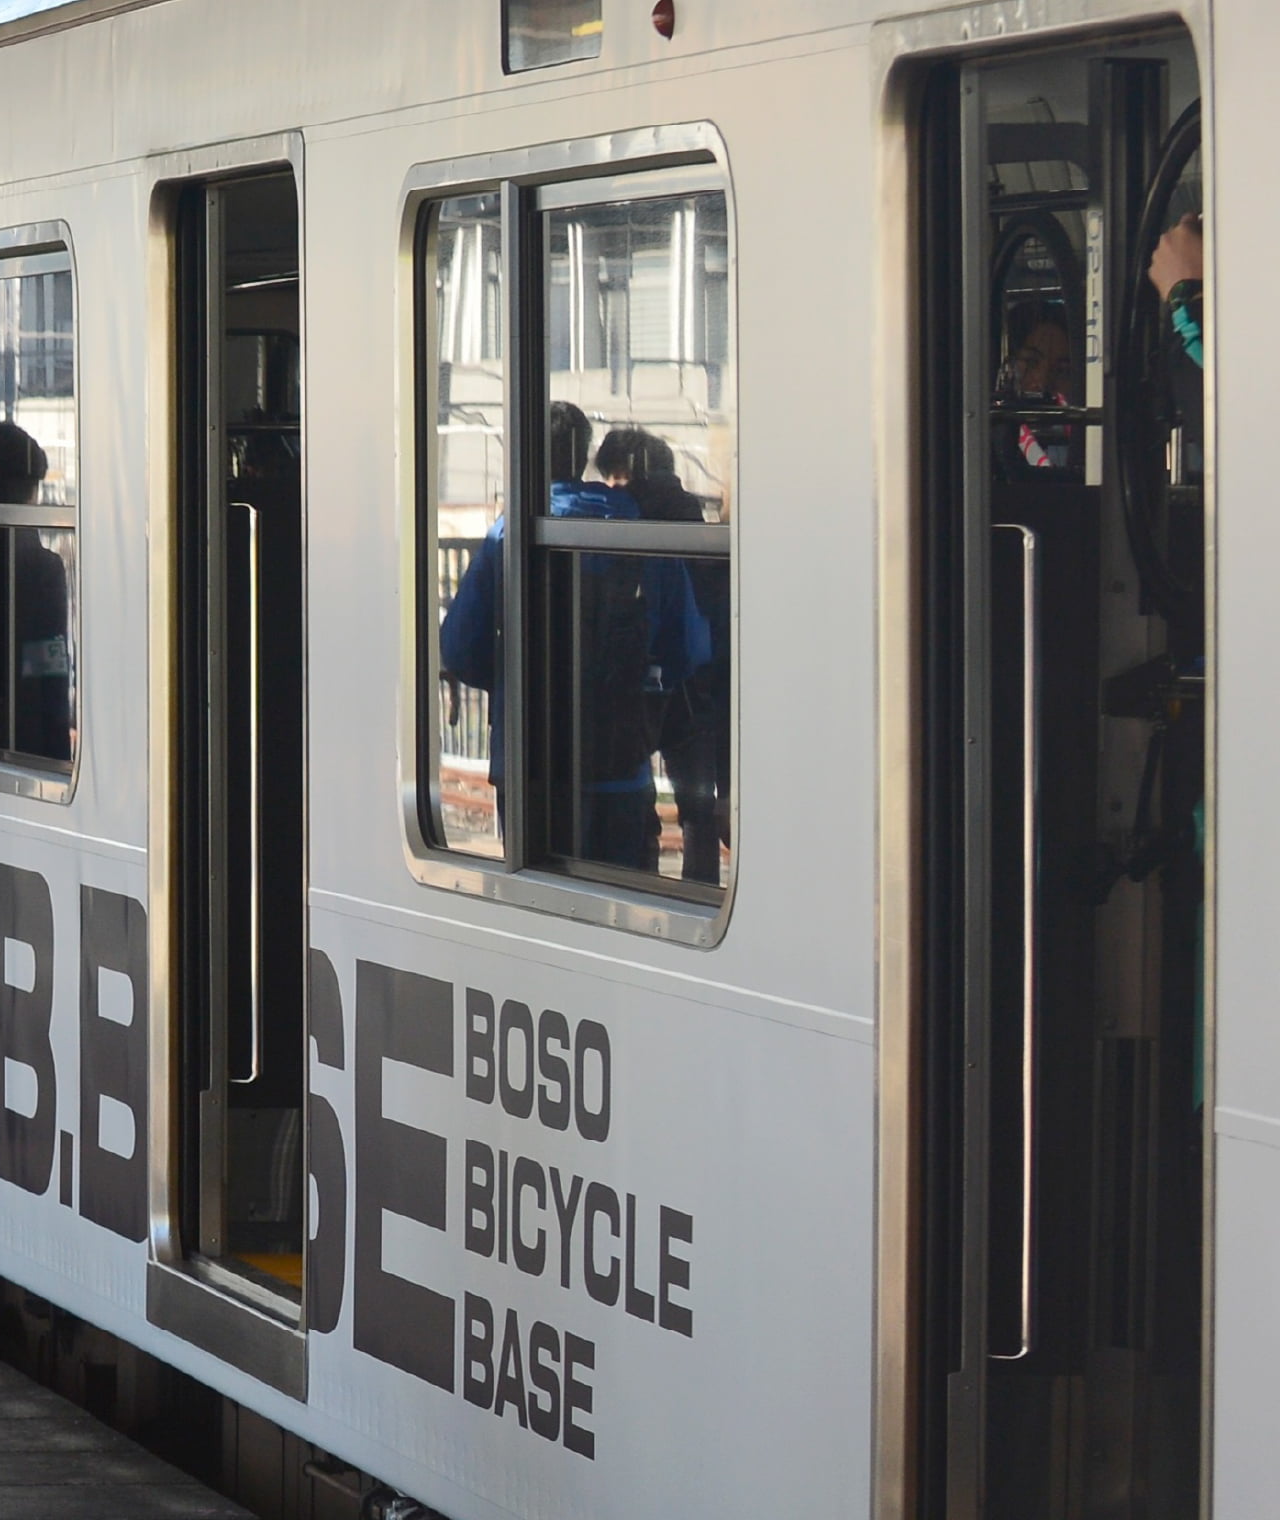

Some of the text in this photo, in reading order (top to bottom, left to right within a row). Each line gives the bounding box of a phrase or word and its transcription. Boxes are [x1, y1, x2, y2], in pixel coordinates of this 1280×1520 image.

[466, 987, 611, 1143] BOSO
[465, 1139, 693, 1339] BICYCLE
[463, 1290, 595, 1461] BASE
